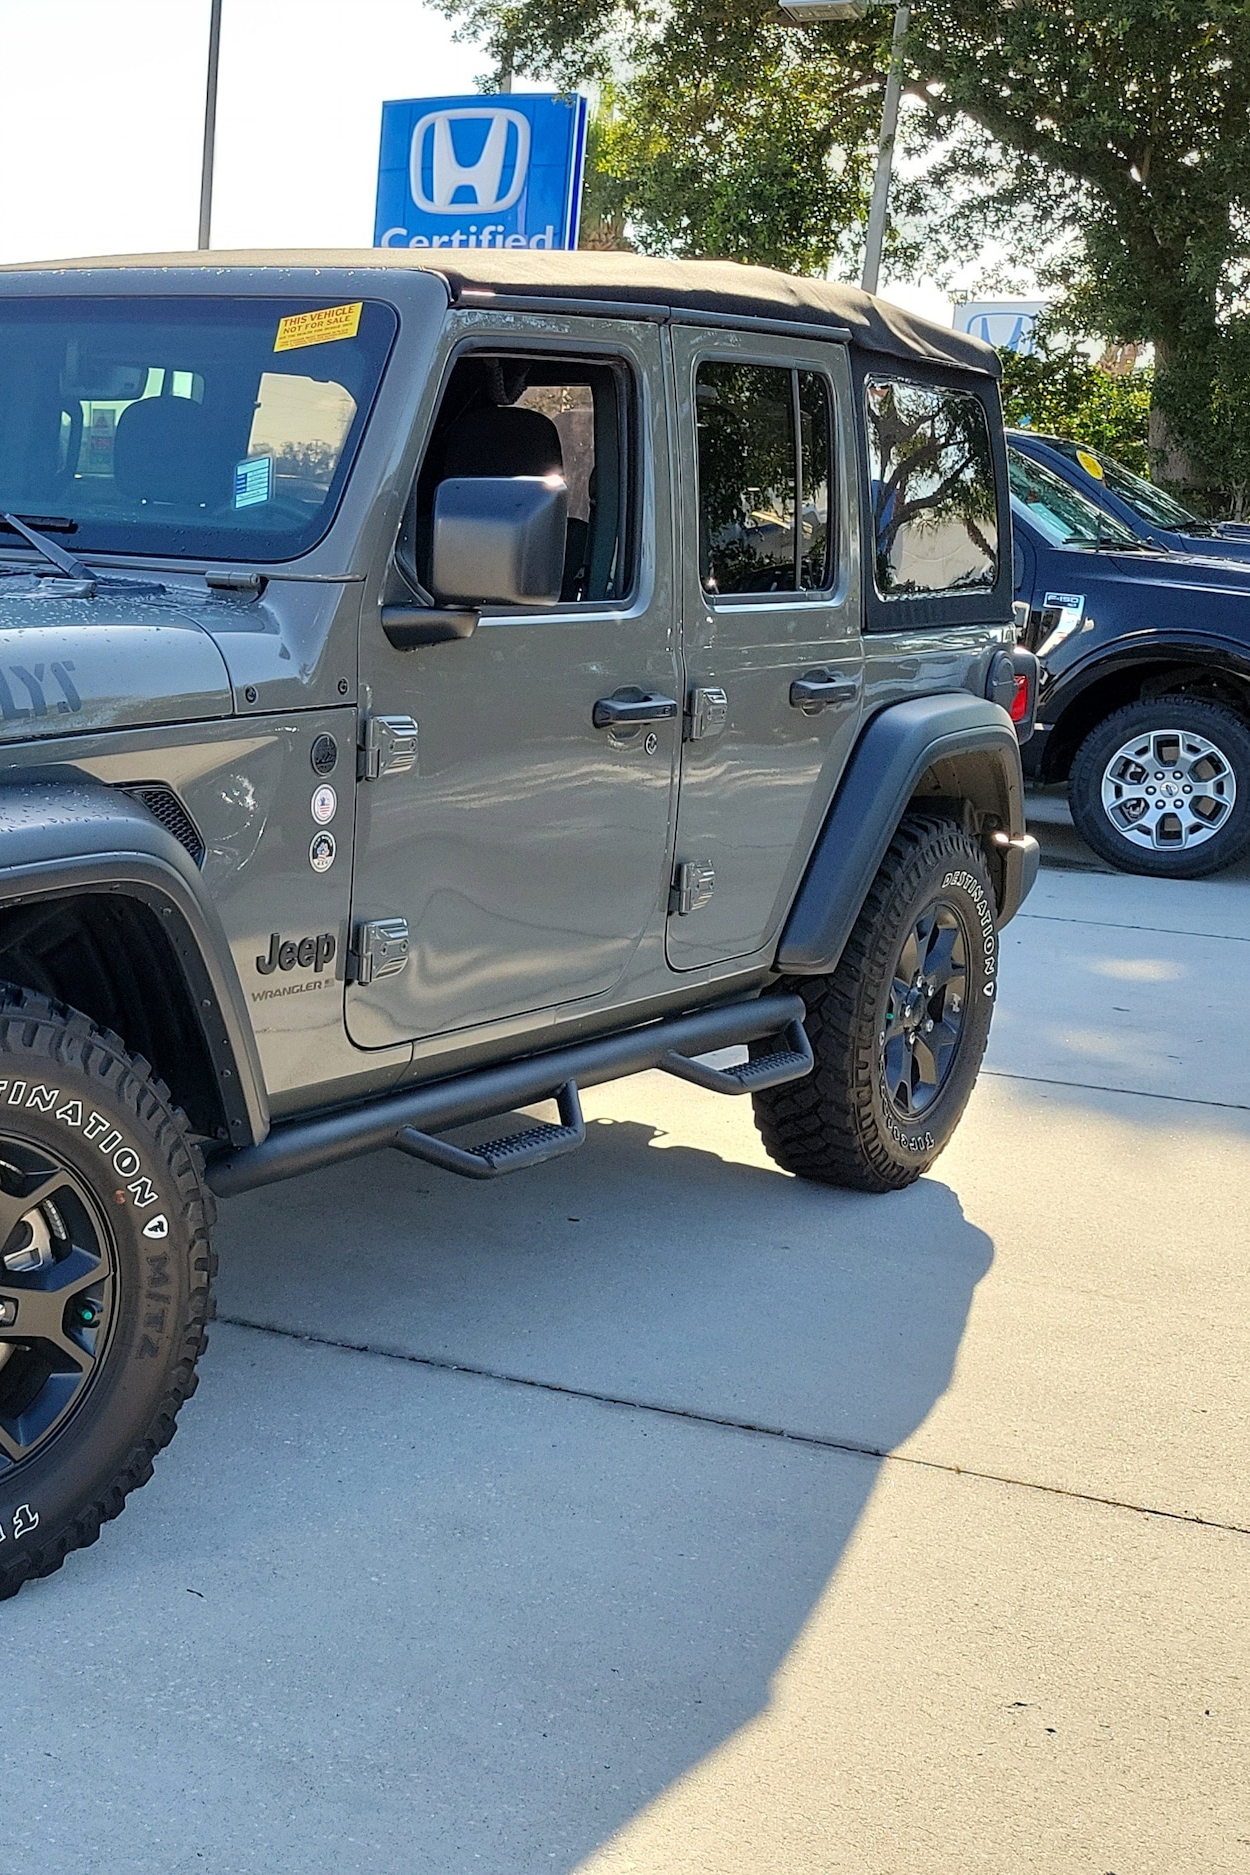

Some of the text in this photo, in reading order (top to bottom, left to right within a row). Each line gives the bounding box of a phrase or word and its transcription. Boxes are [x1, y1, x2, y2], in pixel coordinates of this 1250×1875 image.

[380, 225, 554, 249] Certified
[283, 305, 356, 327] THIS VEHICLE
[283, 325, 302, 335] NOT
[304, 321, 324, 331] FOR
[327, 315, 351, 325] SALE
[941, 871, 996, 976] DESTINATION
[256, 932, 336, 975] Jeep
[251, 981, 322, 1002] WRANGLER
